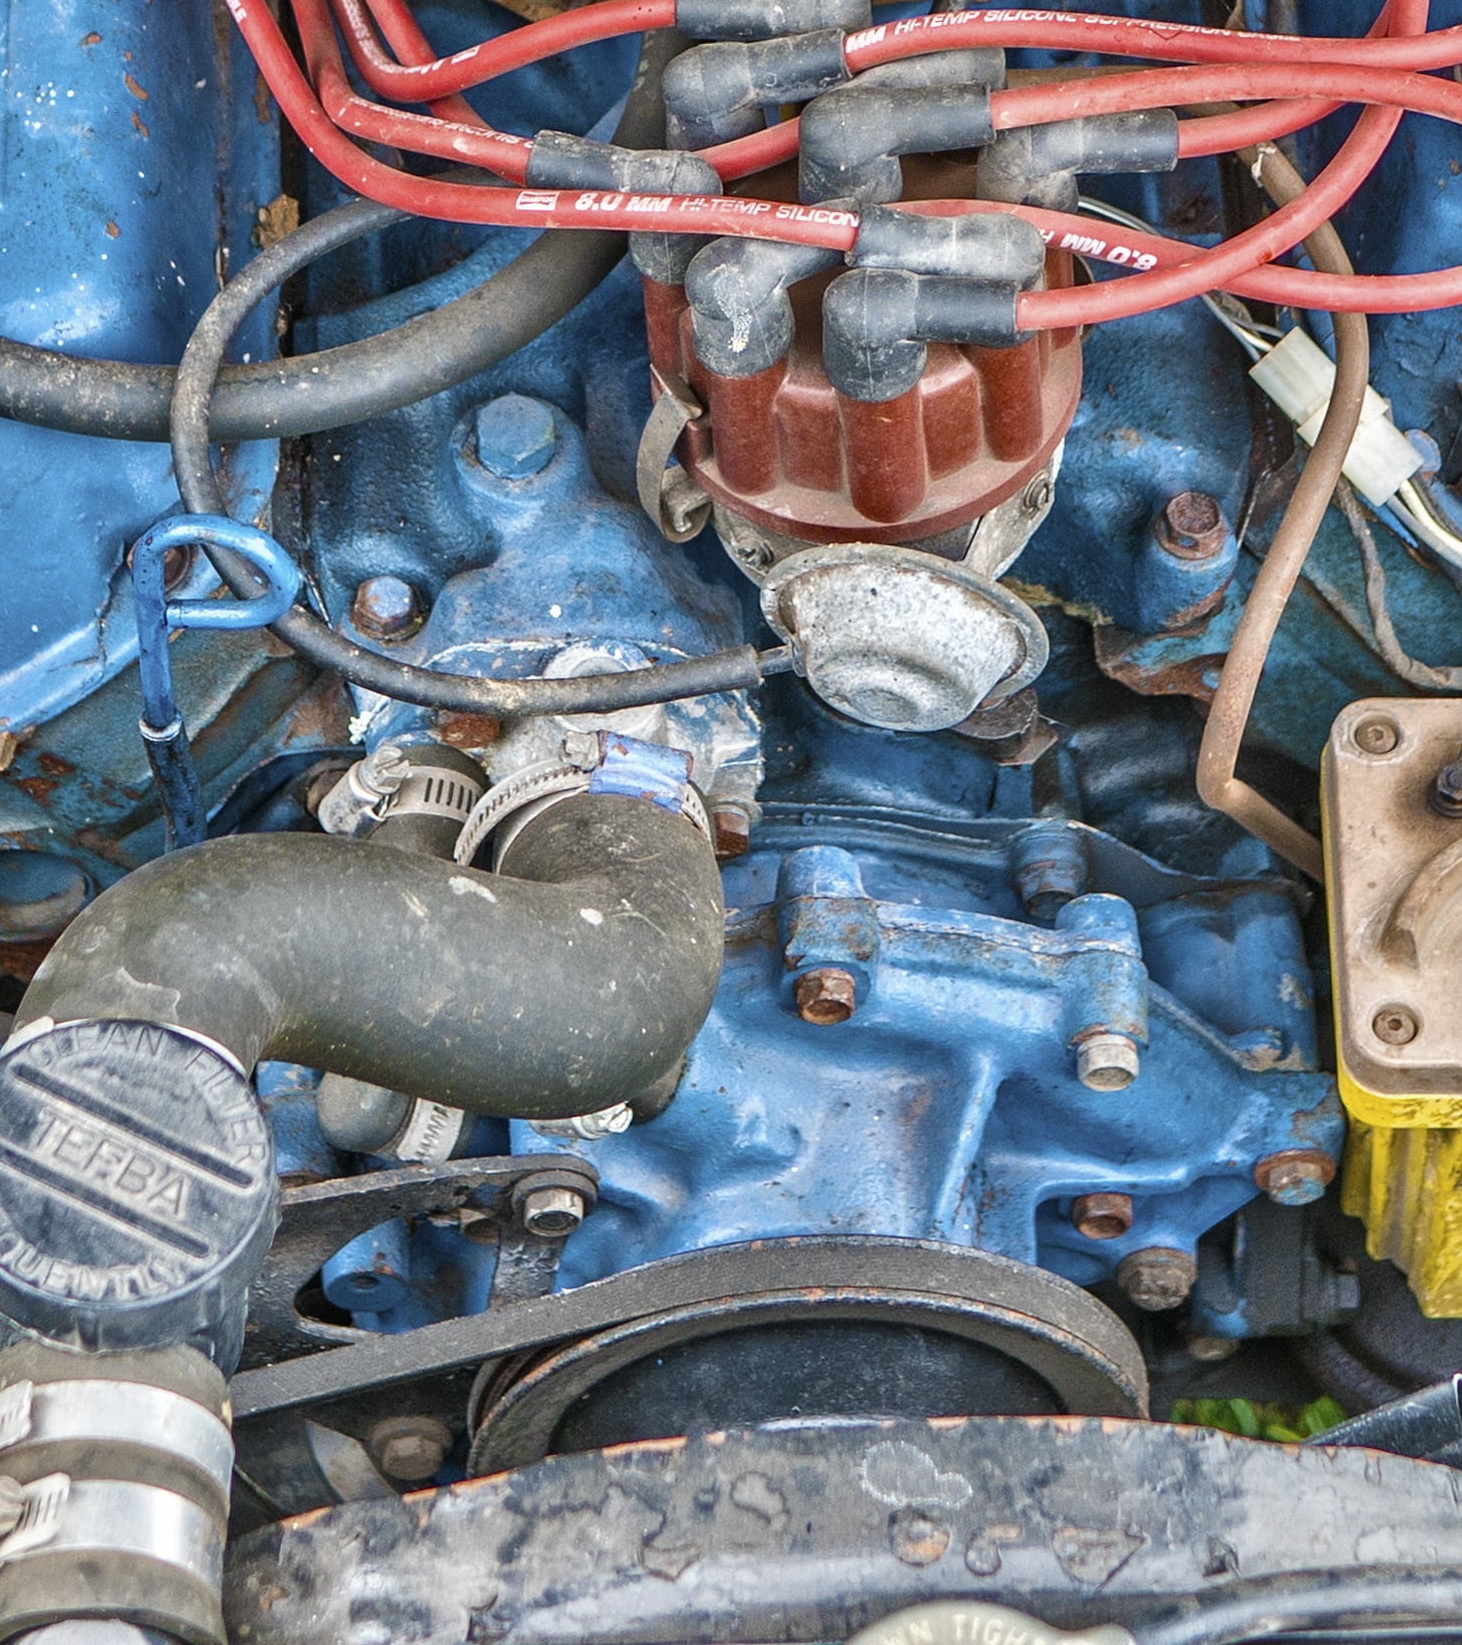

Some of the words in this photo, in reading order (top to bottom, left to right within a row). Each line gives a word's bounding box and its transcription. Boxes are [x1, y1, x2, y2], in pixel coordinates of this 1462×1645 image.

[894, 10, 980, 36] HI-TEMP
[574, 193, 622, 211] 8.0
[625, 196, 673, 213] MM
[679, 196, 771, 216] HI-TEMP
[1061, 232, 1106, 256] MM
[1107, 248, 1158, 272] 8.0
[34, 1106, 192, 1220] TEFBA
